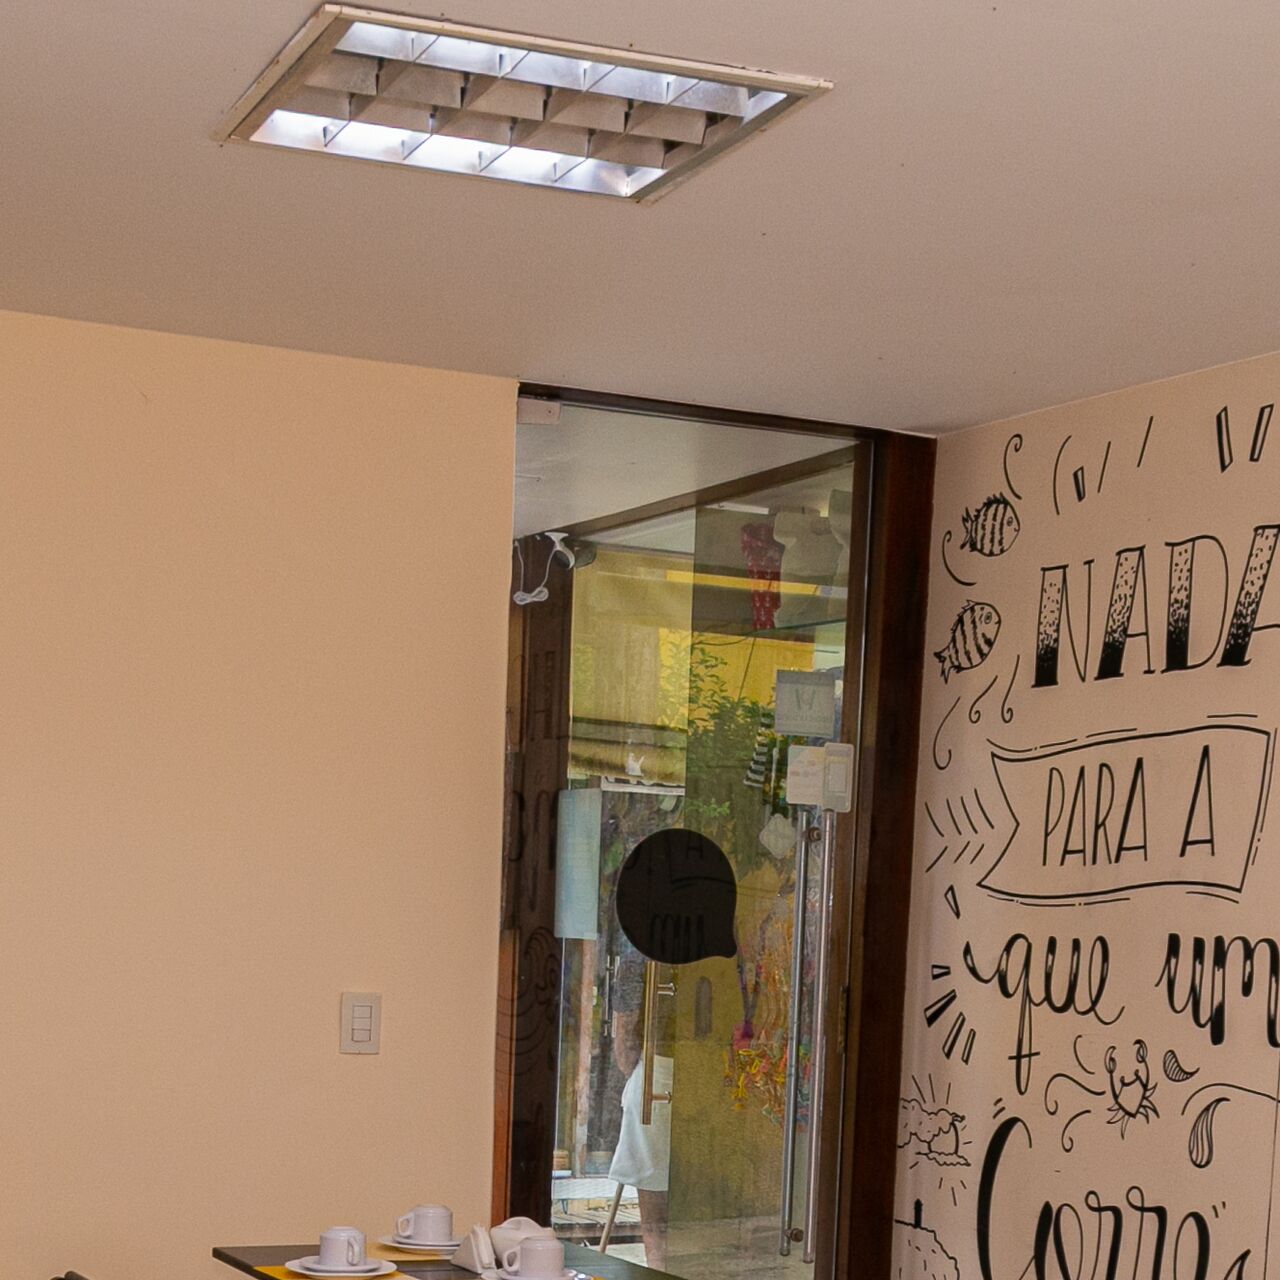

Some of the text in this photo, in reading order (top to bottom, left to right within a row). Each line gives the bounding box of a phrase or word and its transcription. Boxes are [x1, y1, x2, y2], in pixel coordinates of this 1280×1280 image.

[1042, 756, 1148, 867] PARA
[1178, 744, 1216, 858] A
[962, 932, 1126, 1096] que
